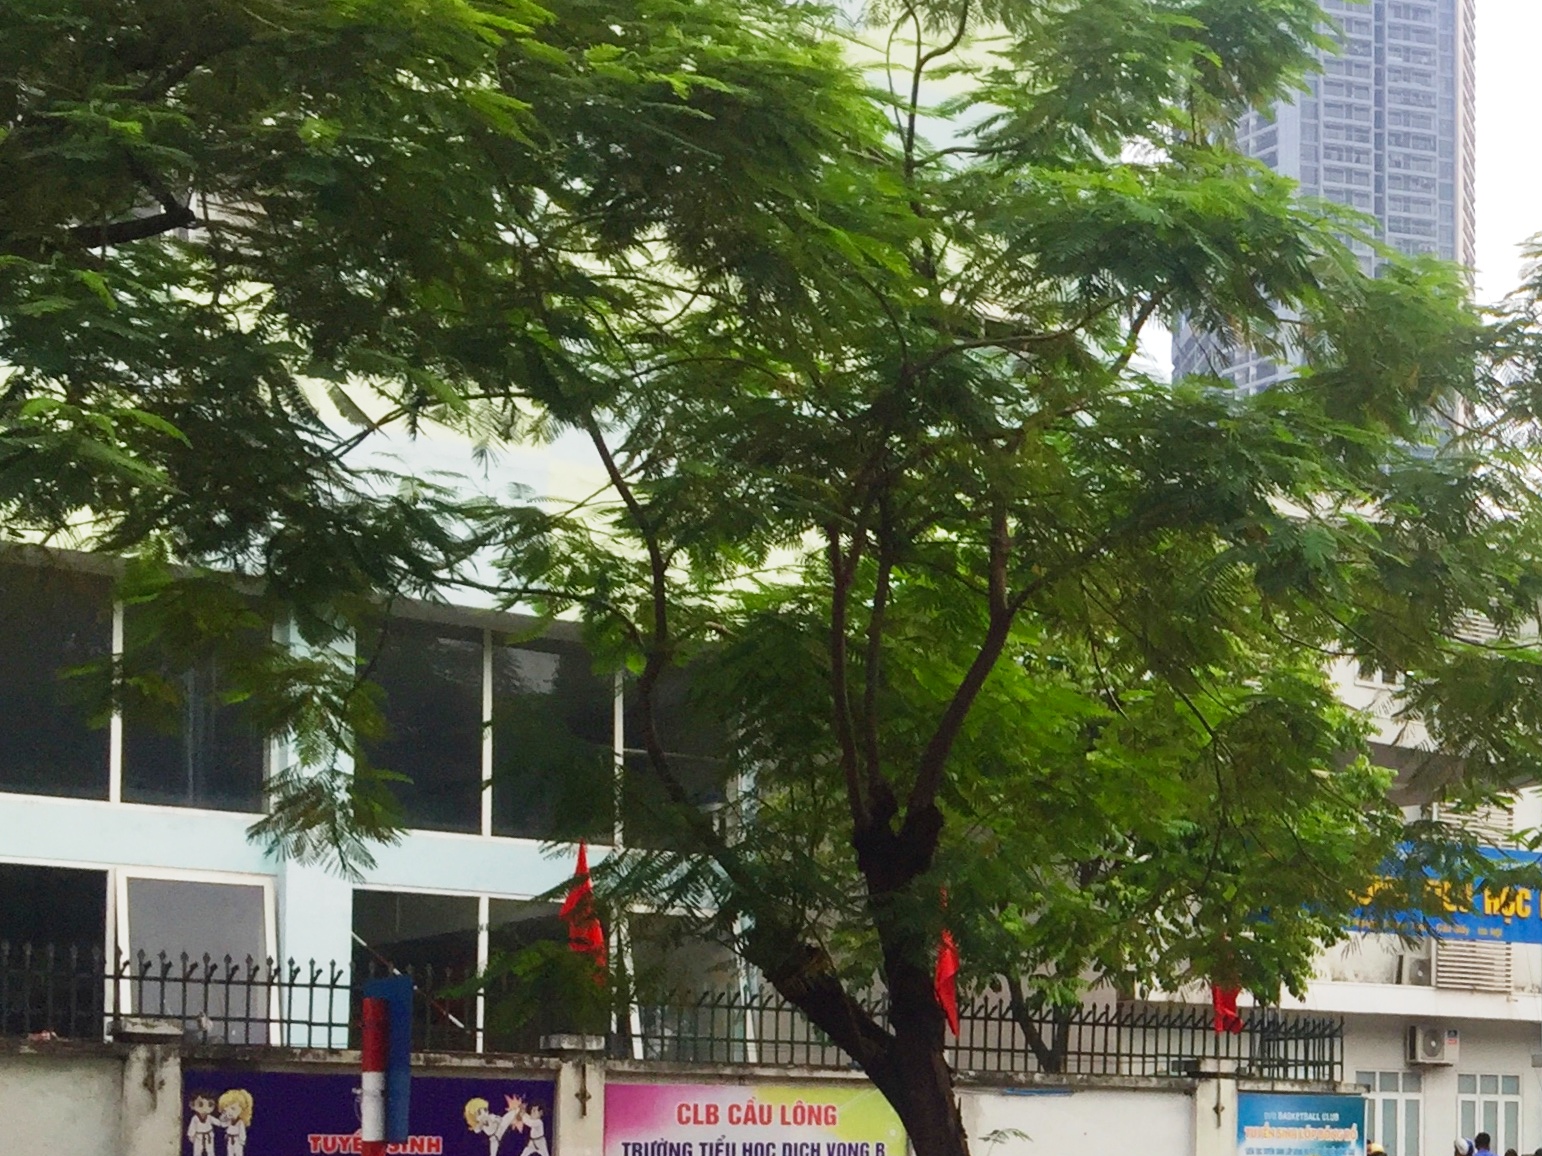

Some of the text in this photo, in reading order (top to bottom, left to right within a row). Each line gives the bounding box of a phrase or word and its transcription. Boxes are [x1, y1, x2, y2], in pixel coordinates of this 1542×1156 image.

[677, 1096, 838, 1127] CLB CẦU LÔNG
